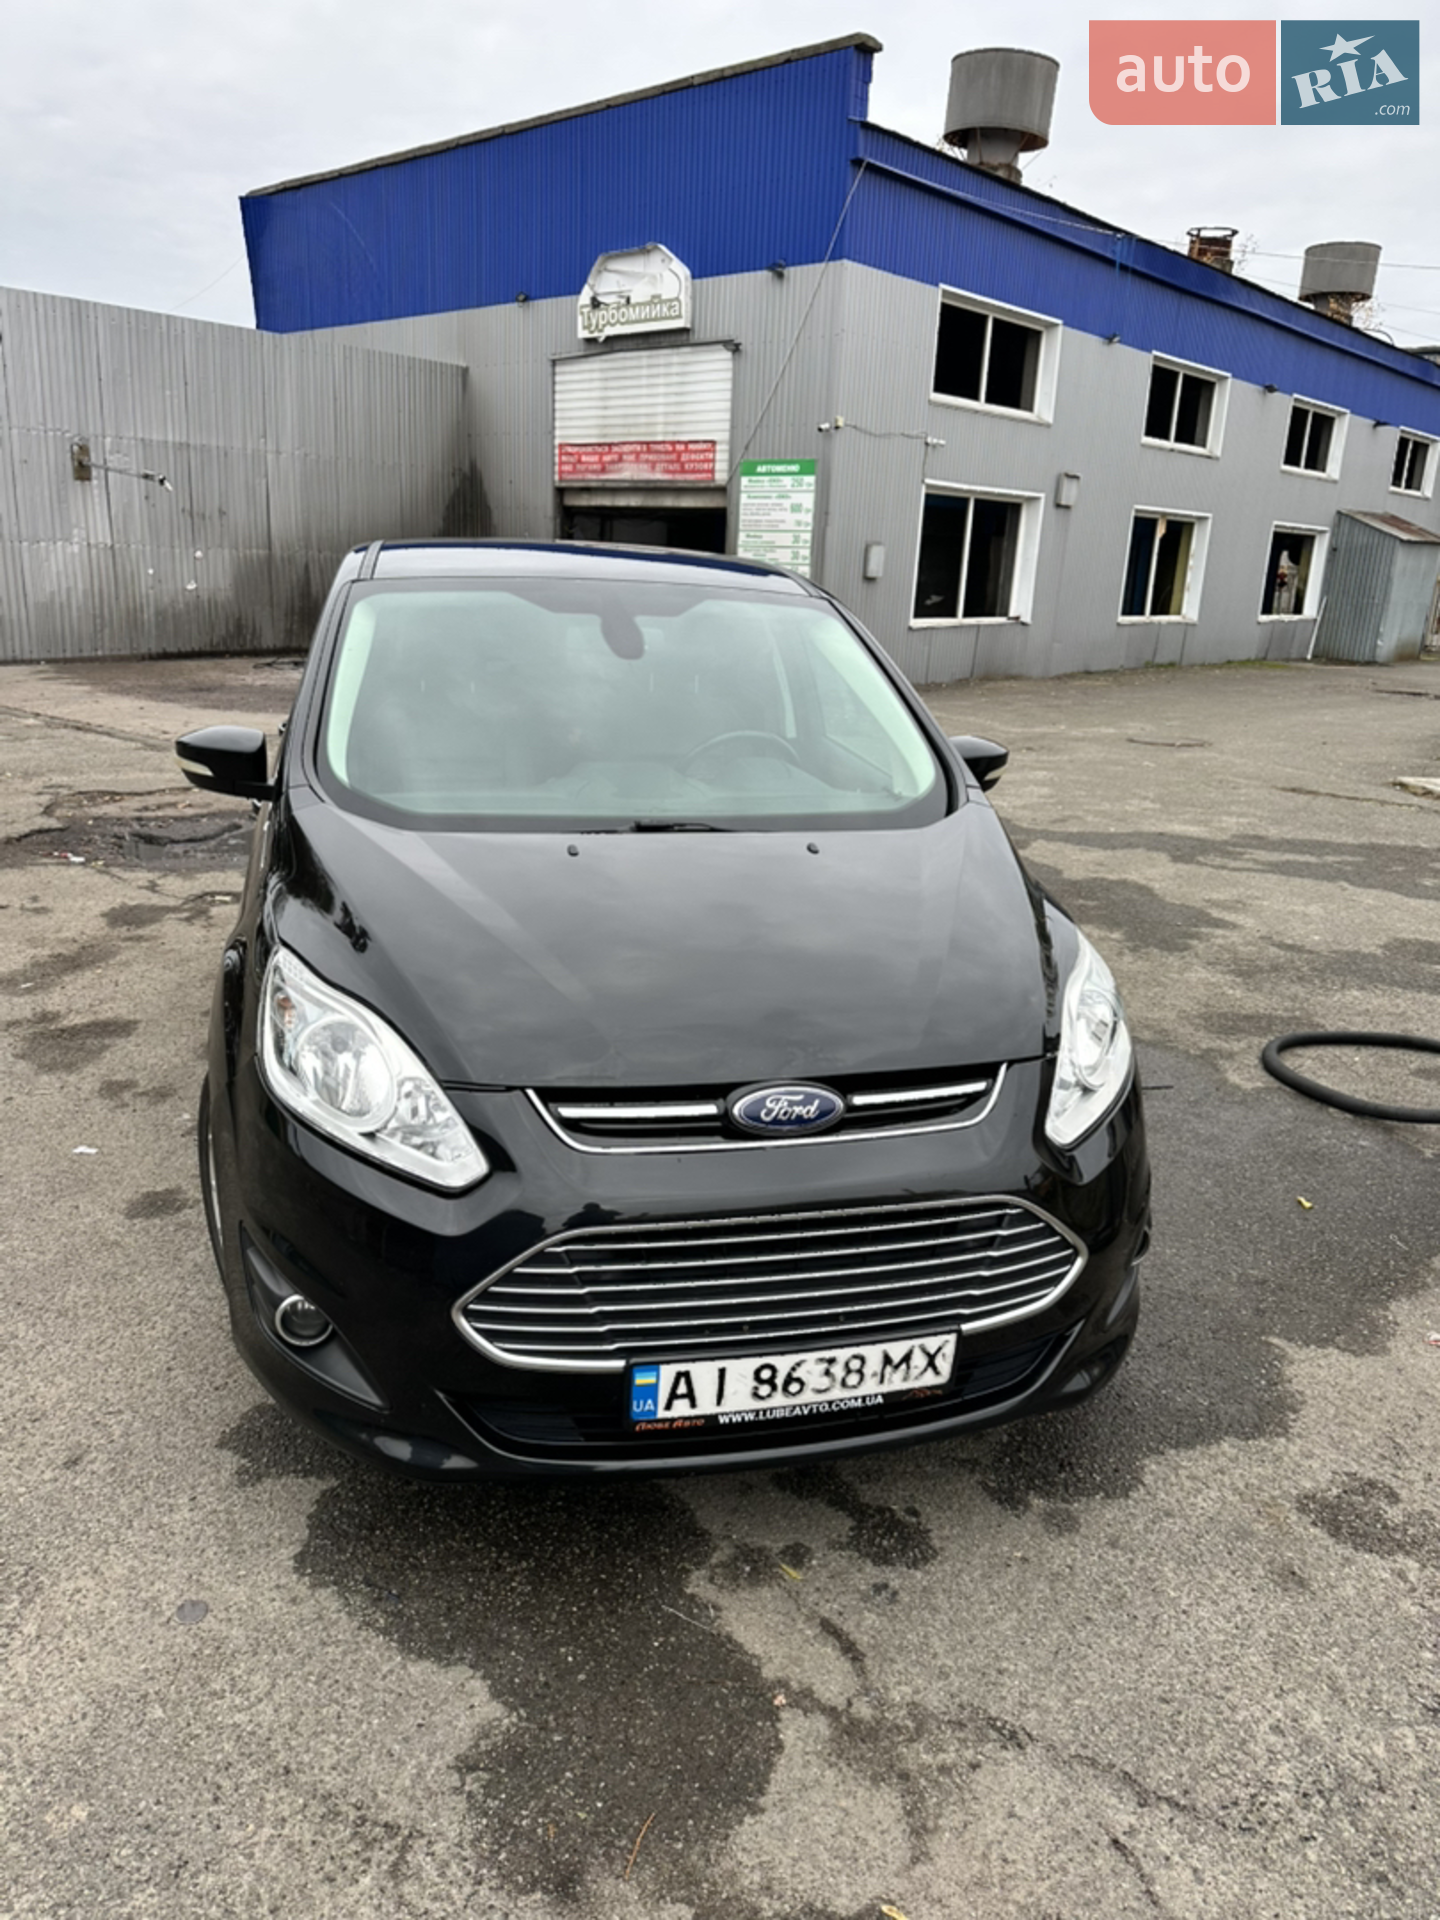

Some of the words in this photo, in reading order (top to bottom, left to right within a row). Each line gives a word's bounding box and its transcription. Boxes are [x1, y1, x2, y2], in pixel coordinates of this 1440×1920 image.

[581, 299, 681, 331] Турбомийка
[760, 1094, 820, 1122] Ford
[664, 1367, 726, 1411] AI
[751, 1354, 866, 1401] 8638
[879, 1340, 949, 1384] MX
[632, 1399, 655, 1412] UA
[717, 1394, 884, 1425] WWW.LUBEAVTO.COM.UA
